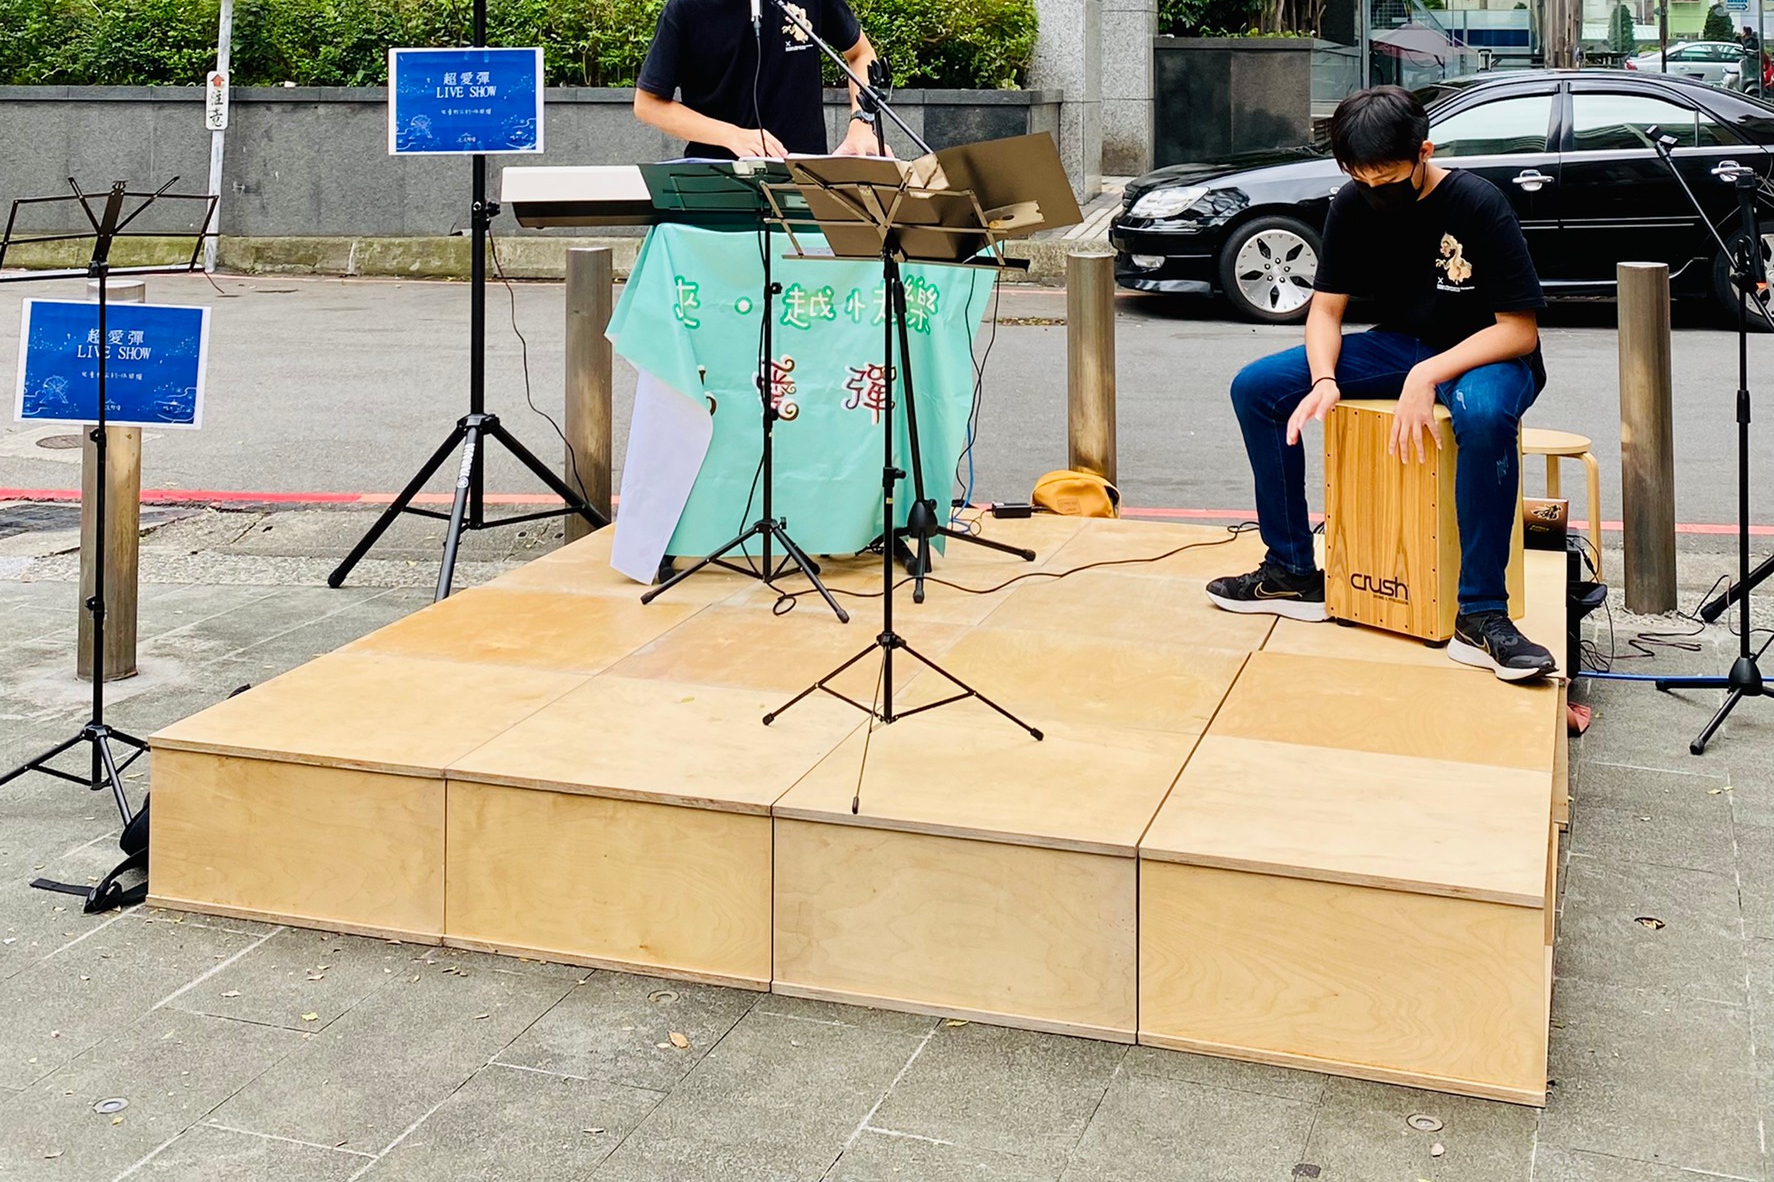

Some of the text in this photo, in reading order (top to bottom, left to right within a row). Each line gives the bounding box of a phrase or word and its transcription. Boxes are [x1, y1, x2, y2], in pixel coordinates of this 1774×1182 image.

[443, 71, 490, 85] 超愛彈
[436, 85, 497, 98] LIVE SHOW
[118, 346, 152, 360] SHOW
[1350, 573, 1409, 600] crush
